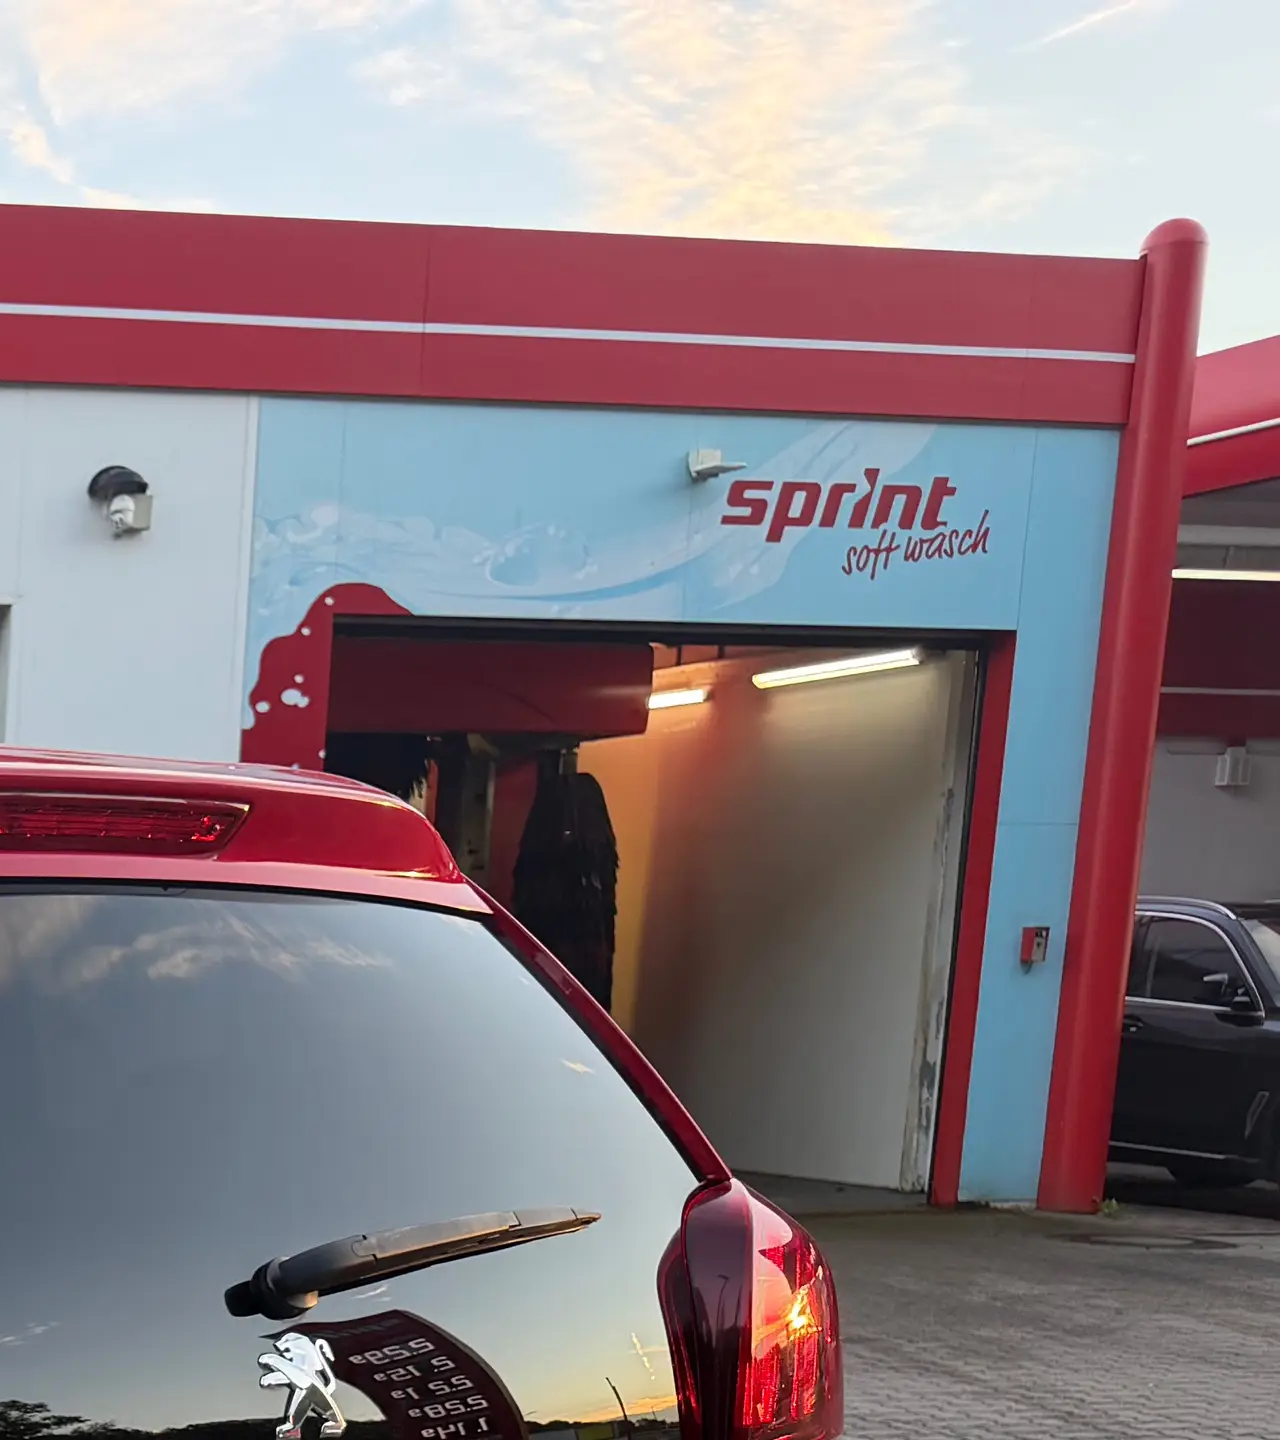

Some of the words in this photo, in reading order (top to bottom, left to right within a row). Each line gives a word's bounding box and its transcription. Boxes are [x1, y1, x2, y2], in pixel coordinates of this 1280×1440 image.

[720, 467, 958, 543] sprint
[840, 528, 900, 582] soft
[902, 509, 991, 564] wasch
